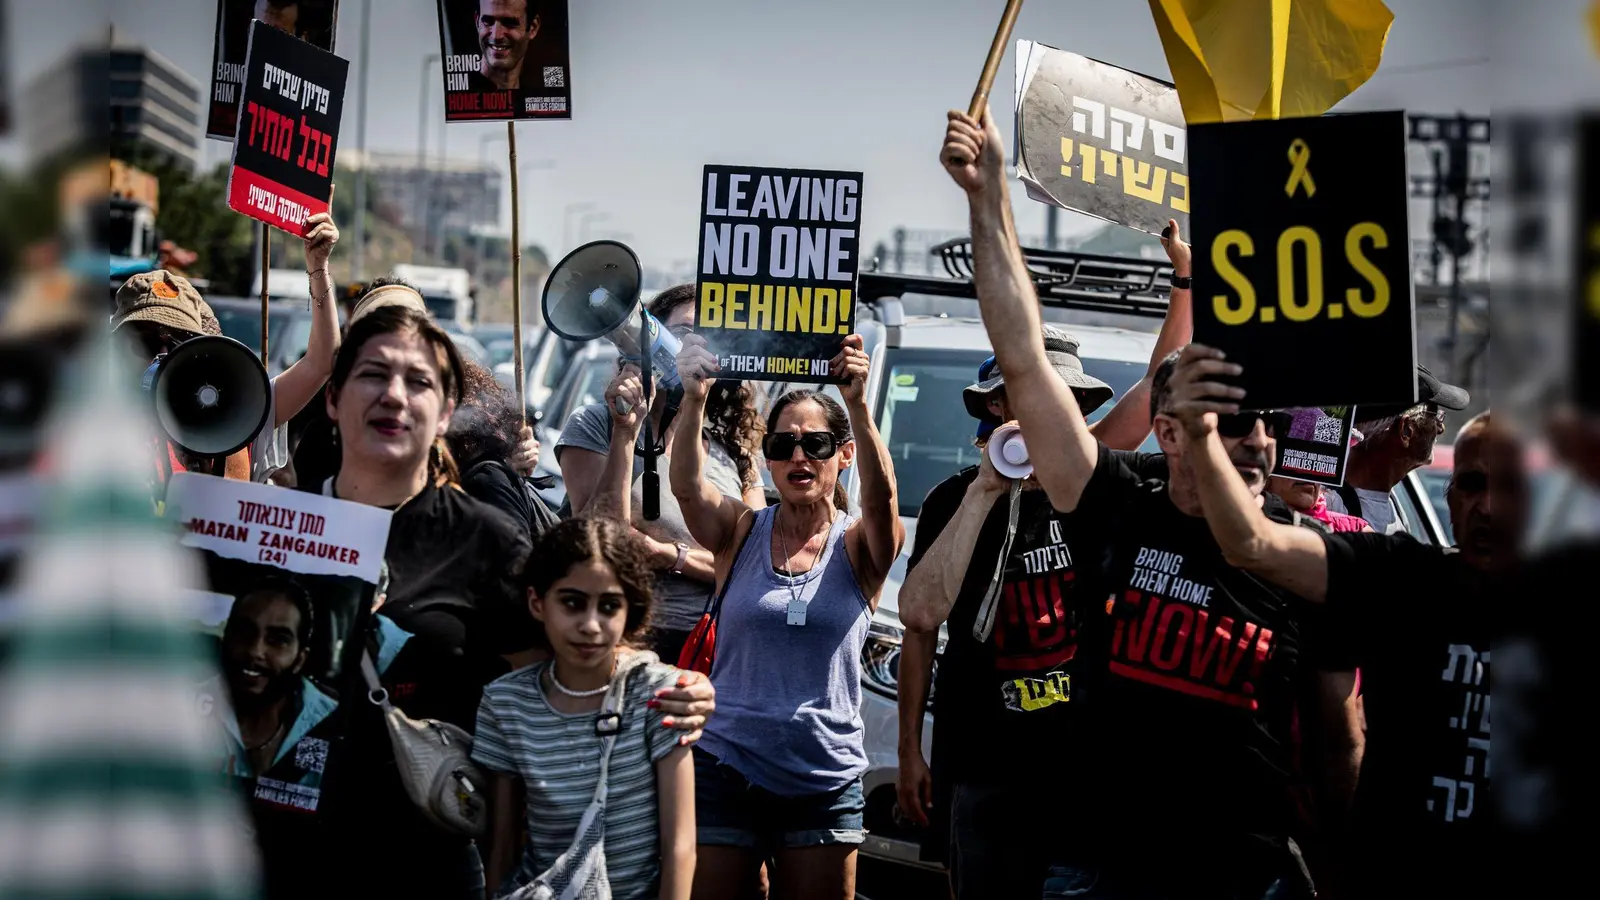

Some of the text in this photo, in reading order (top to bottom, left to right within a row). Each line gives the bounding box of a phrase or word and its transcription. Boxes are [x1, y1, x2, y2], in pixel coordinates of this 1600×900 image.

[447, 54, 481, 72] BRING
[214, 82, 236, 103] HIM
[262, 62, 331, 115] פדיון שבויים
[447, 73, 469, 91] HIM
[448, 93, 480, 111] HOME
[525, 102, 567, 111] FAMILIES FORUM
[247, 100, 295, 162] מחיר
[1072, 96, 1187, 164] סקה
[297, 114, 333, 178] בכל
[1060, 136, 1190, 214] כשיו!
[247, 183, 278, 215] עכשיו!
[706, 172, 858, 222] LEAVING
[702, 222, 856, 281] NO ONE
[1210, 221, 1391, 326] S.O.S
[699, 281, 852, 335] BEHIND!
[729, 354, 766, 373] THEM
[766, 357, 809, 375] HOME!
[811, 359, 829, 376] NO
[1282, 455, 1337, 474] FAMILIES FORUM
[1284, 448, 1338, 465] HOSTAGES AND MISSING
[298, 511, 326, 537] מתן
[191, 517, 360, 566] MATAN ZANGAUKER
[258, 548, 288, 566] (24)
[1023, 543, 1073, 574] הביתה
[1135, 546, 1184, 575] BRING
[1129, 567, 1214, 608] THEM HOME
[1110, 589, 1274, 695] NOW!
[254, 784, 290, 805] FAMILIES
[290, 793, 319, 811] FORUM
